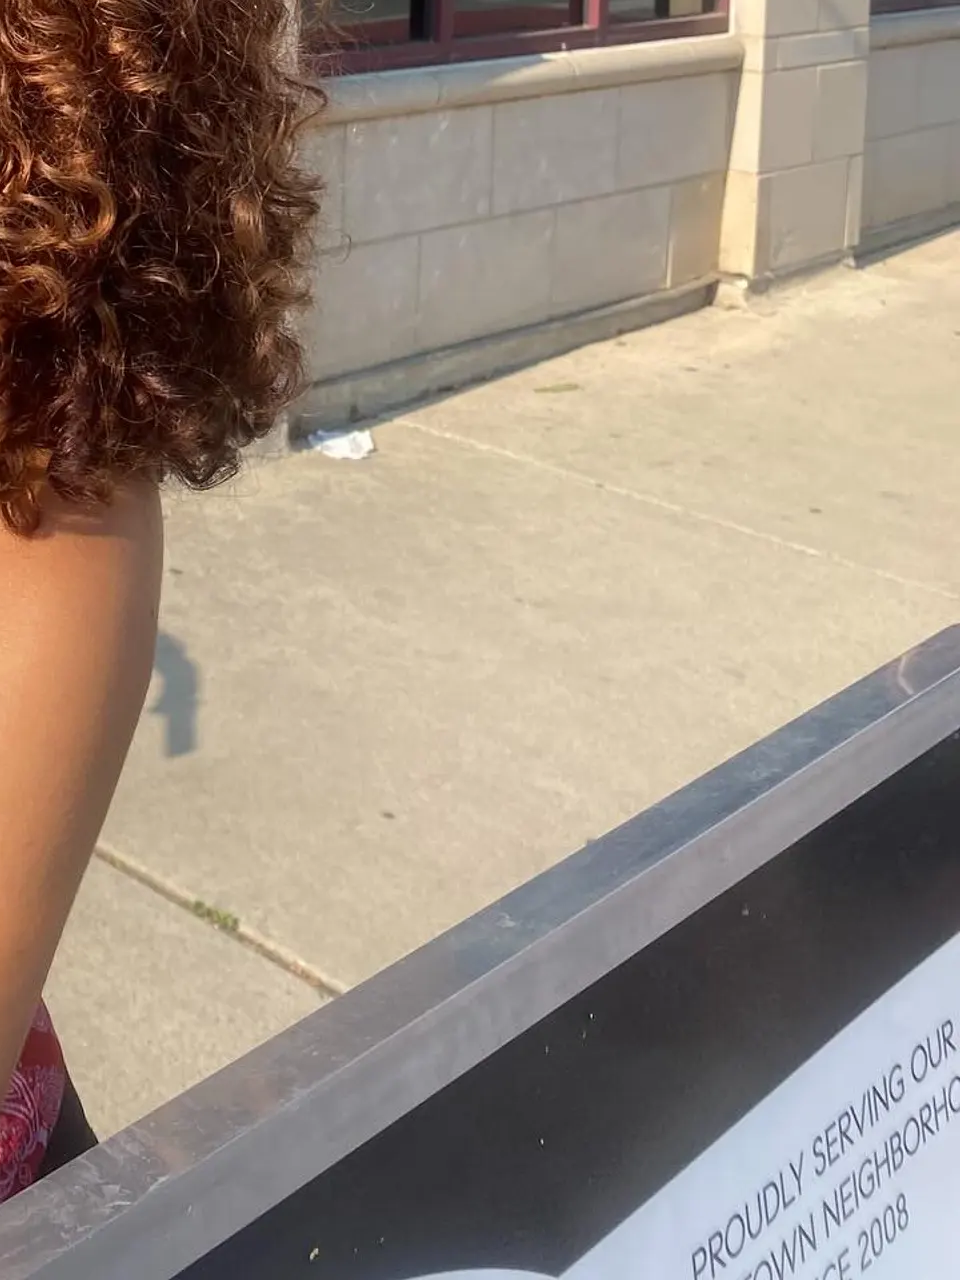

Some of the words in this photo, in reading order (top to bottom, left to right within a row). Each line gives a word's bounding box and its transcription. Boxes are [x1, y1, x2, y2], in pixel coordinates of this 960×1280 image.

[691, 1150, 804, 1280] PROUDLY
[812, 1064, 905, 1176] SERVING
[910, 1019, 956, 1083] OUR
[858, 1192, 909, 1272] 2008
